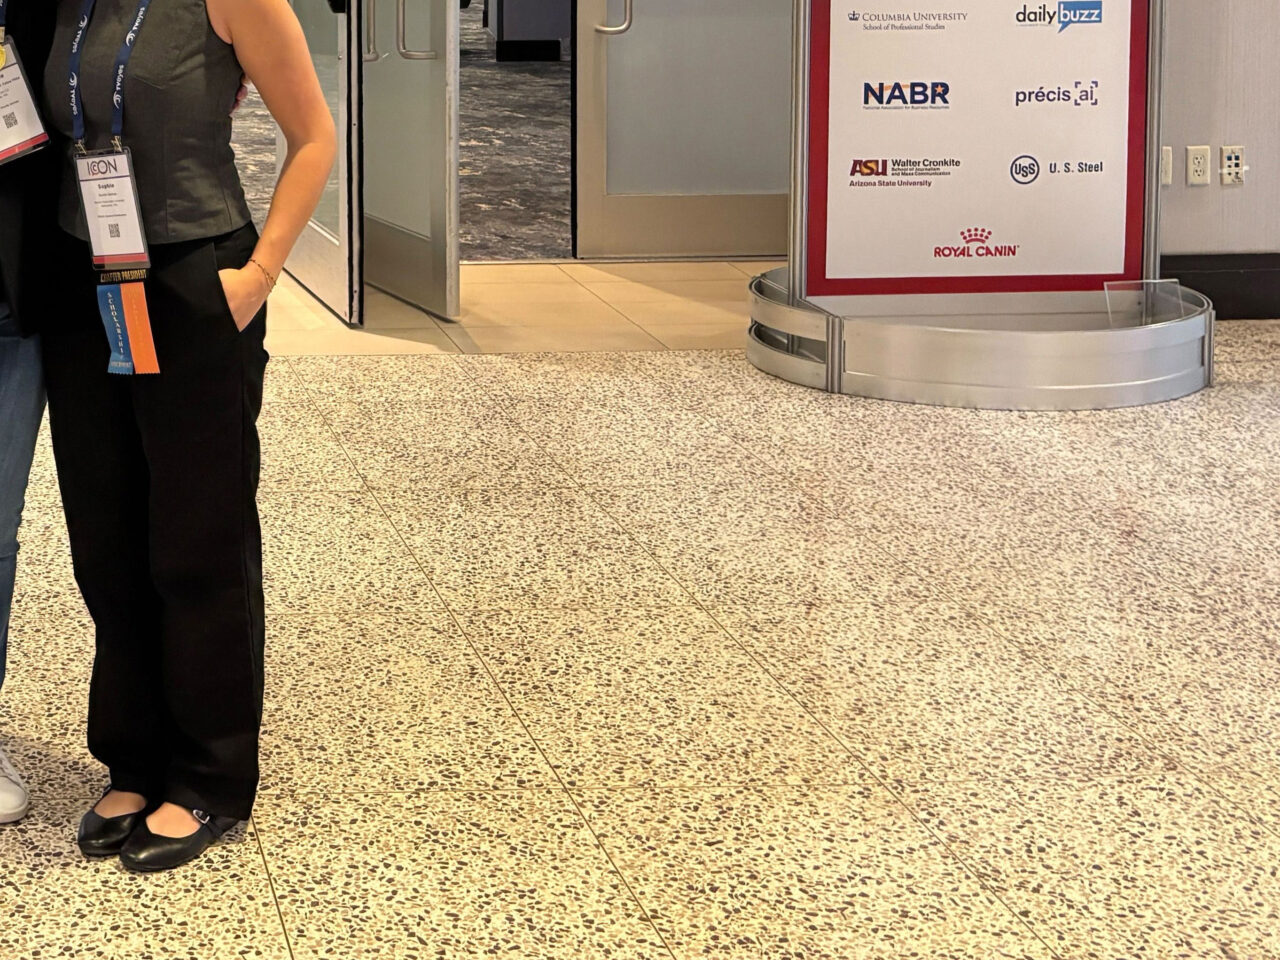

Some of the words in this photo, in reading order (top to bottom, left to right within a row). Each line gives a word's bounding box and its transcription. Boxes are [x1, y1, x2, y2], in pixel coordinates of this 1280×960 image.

[862, 12, 911, 22] COLUMBIA
[913, 12, 969, 21] UNIVERSITY
[1015, 3, 1057, 25] daily
[1060, 3, 1101, 22] buzz
[863, 82, 950, 105] NABR
[1015, 87, 1072, 107] précis
[850, 159, 888, 176] ASU
[891, 159, 922, 167] Walter
[922, 158, 961, 167] Cronkite
[1077, 161, 1103, 173] Steel
[897, 180, 932, 188] University
[934, 245, 973, 258] ROYAL
[975, 245, 1017, 257] CANIN
